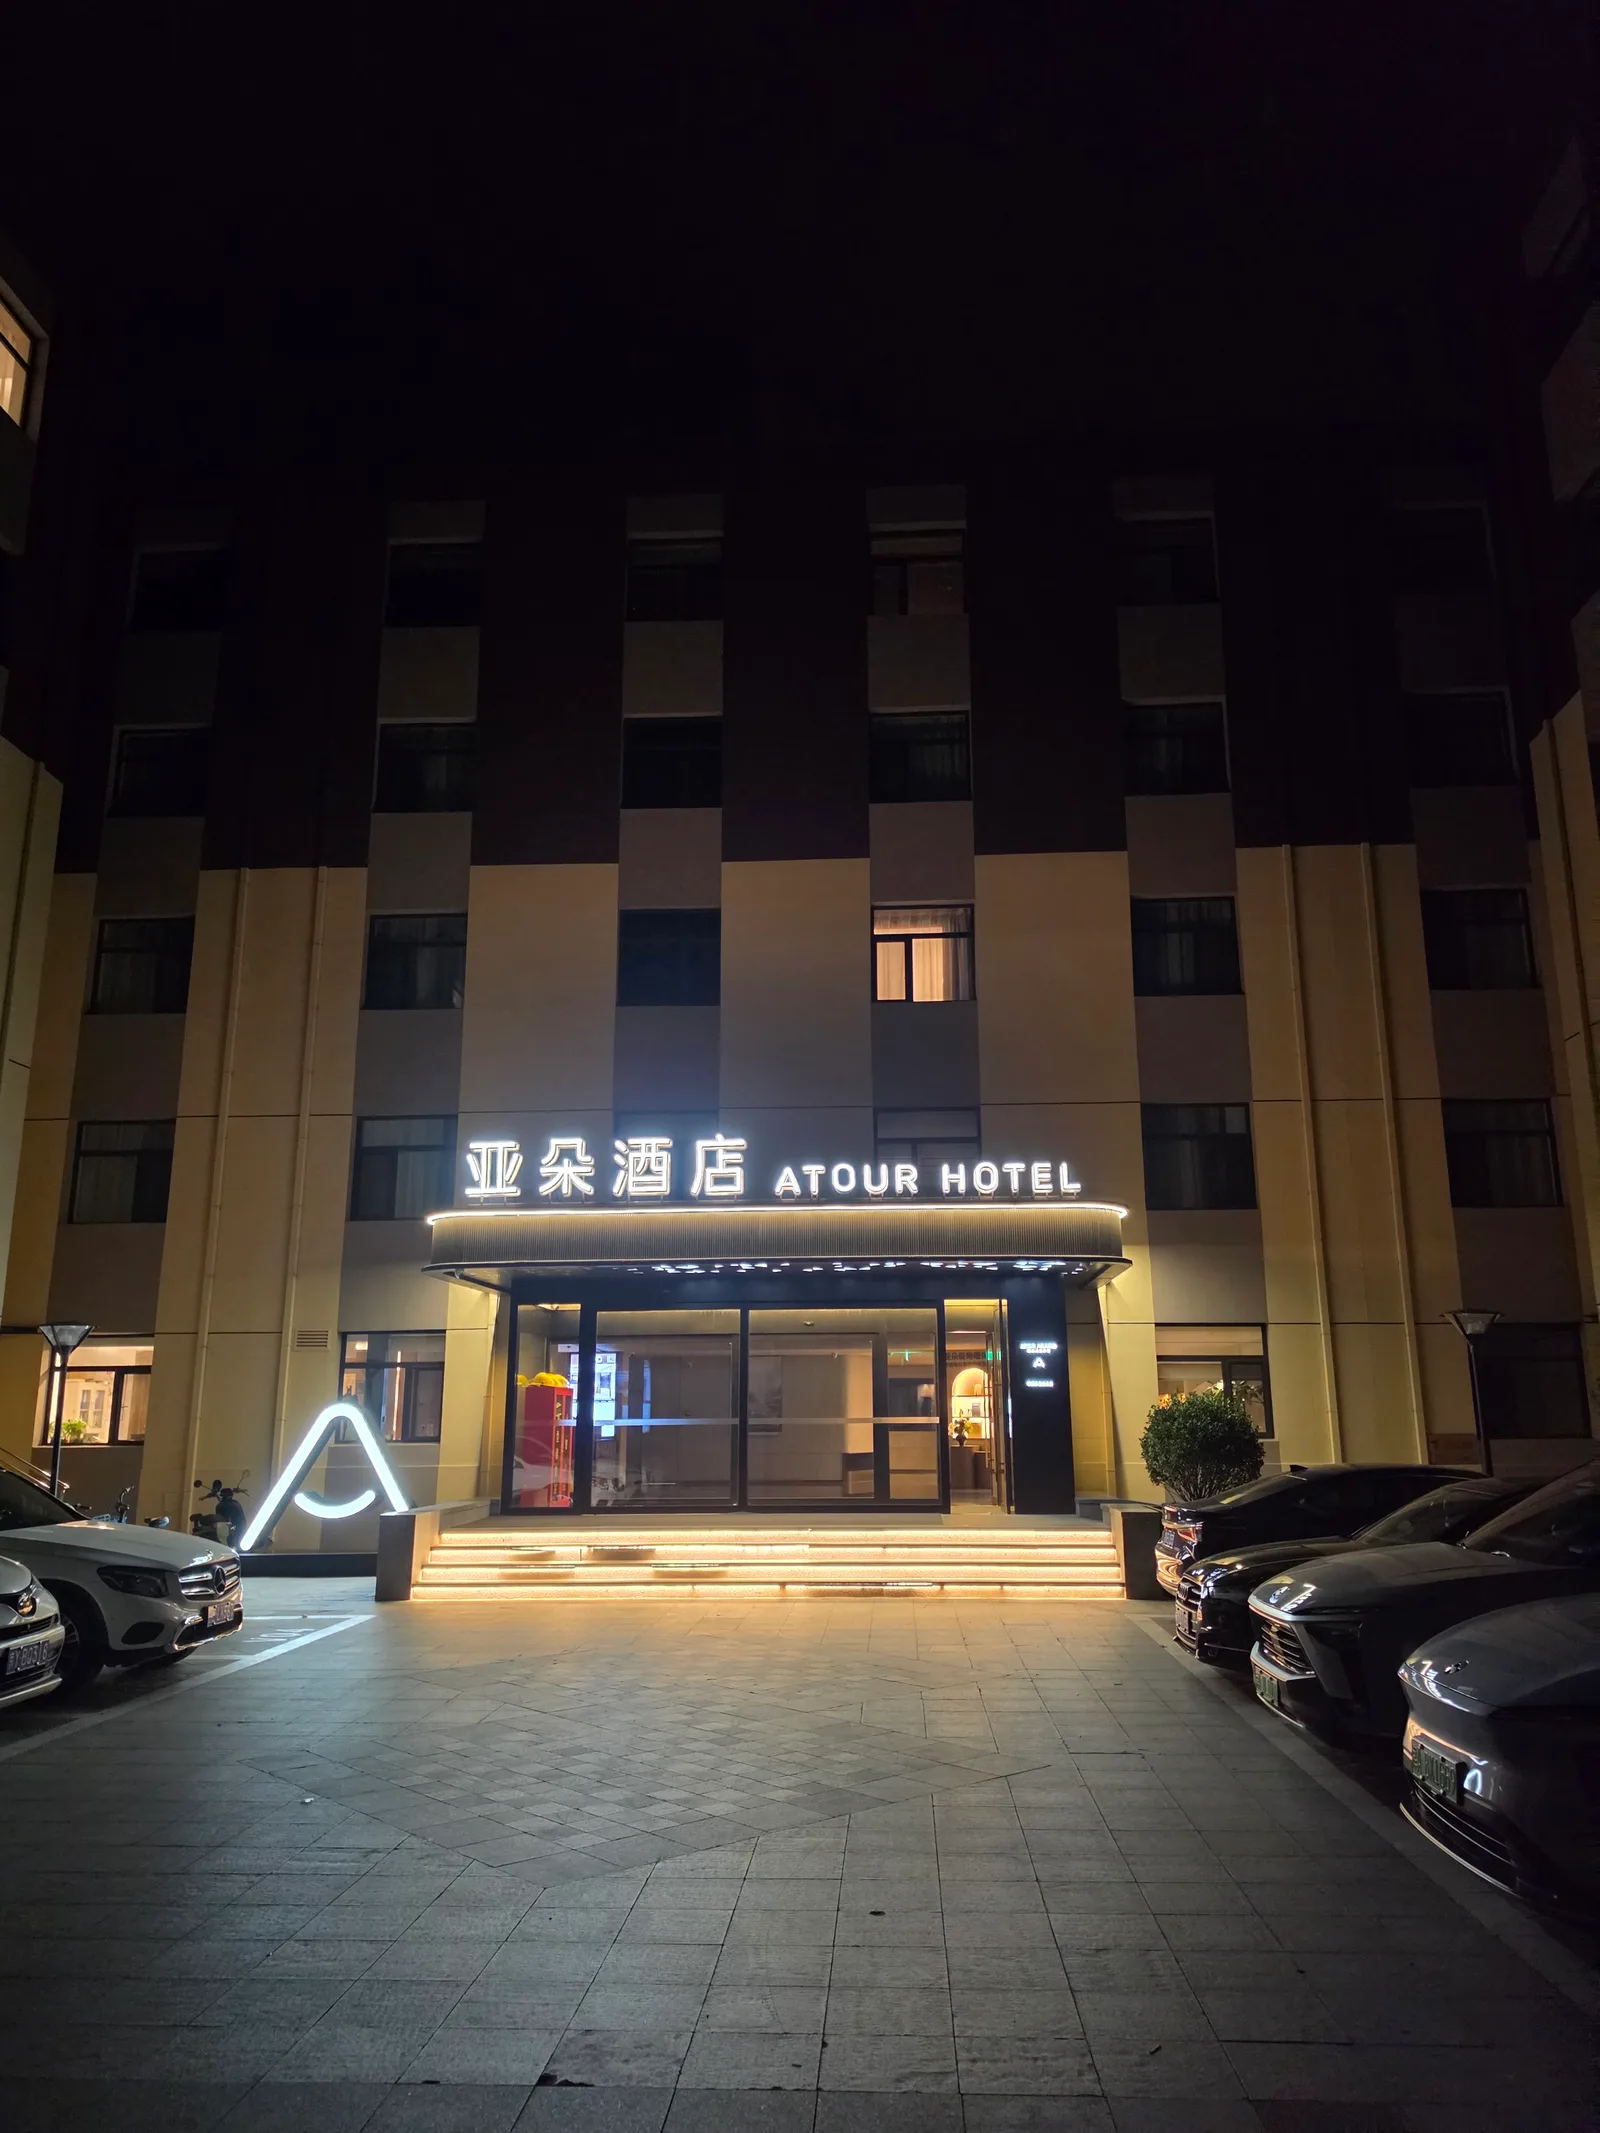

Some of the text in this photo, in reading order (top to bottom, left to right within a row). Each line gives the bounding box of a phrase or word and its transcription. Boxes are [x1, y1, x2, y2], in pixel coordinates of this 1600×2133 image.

[465, 1134, 746, 1196] 亚朵酒店
[774, 1161, 1081, 1195] ATOUR HOTEL
